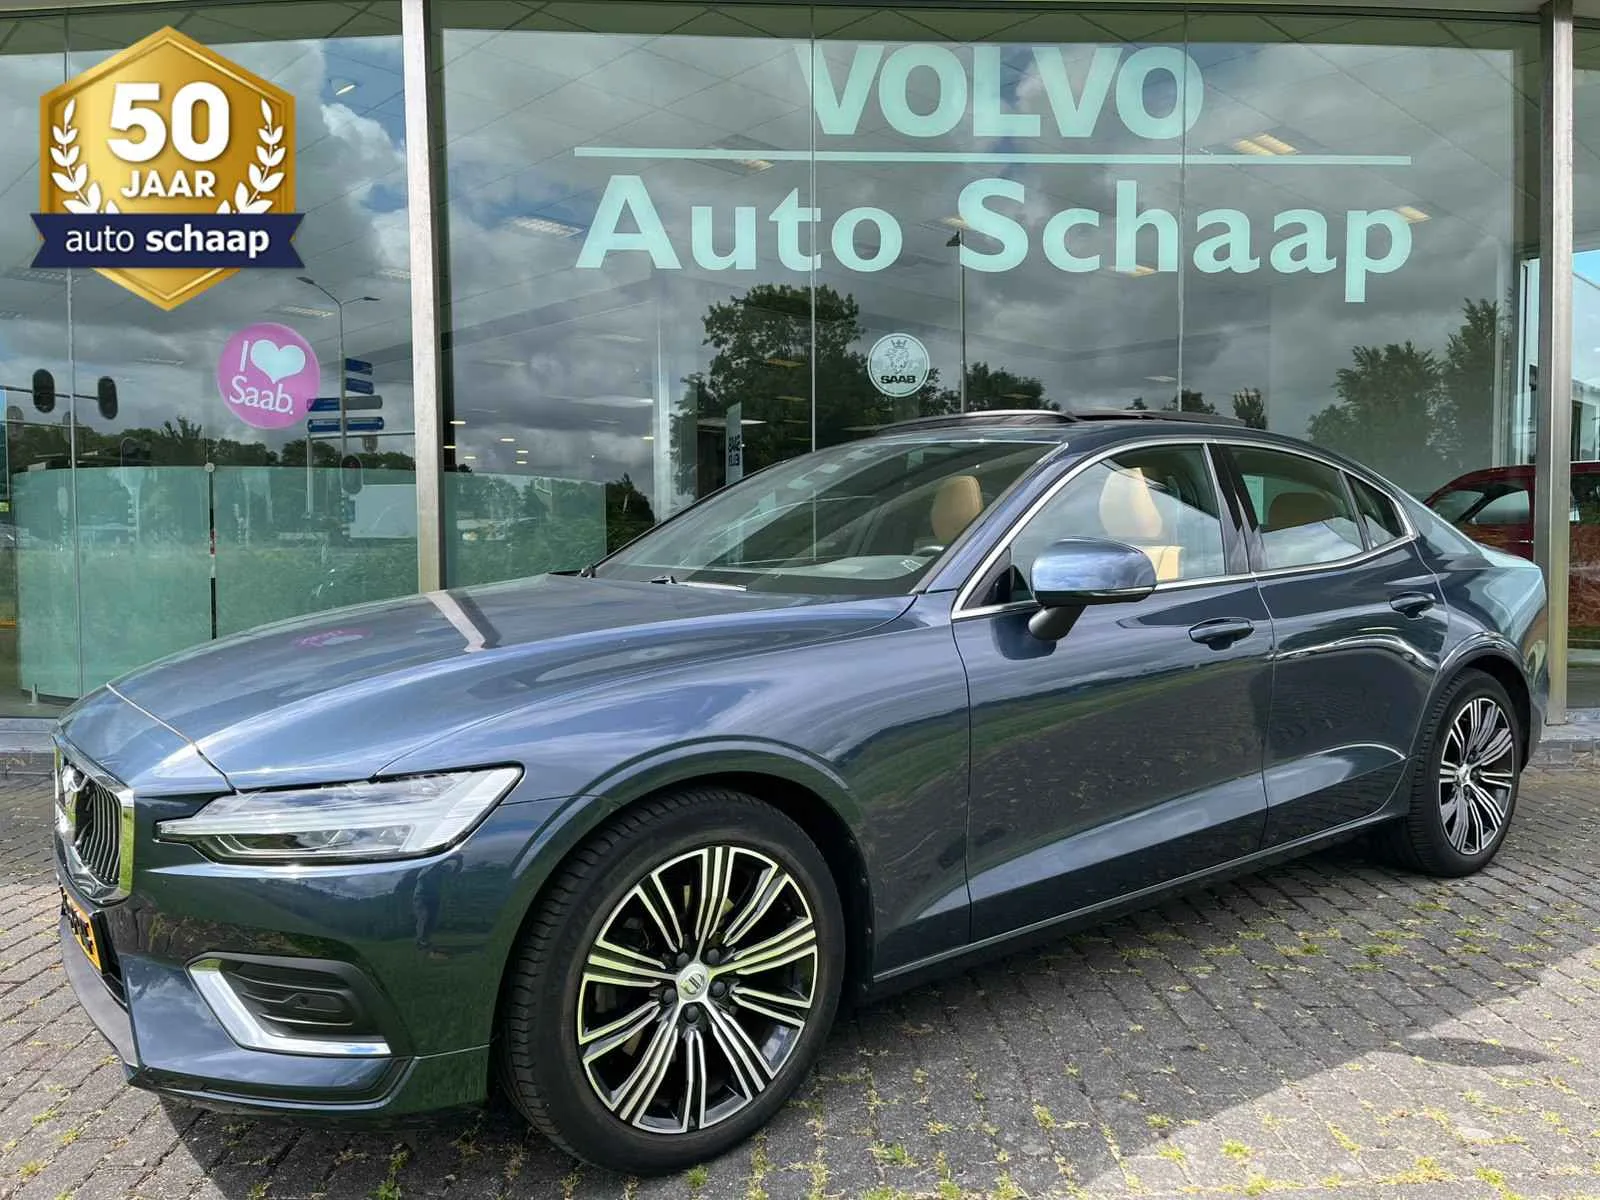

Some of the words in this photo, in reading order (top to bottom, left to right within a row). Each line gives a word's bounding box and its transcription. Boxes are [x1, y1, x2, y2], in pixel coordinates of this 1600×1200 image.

[793, 43, 1204, 140] VOLVO
[575, 174, 904, 273] Auto
[957, 177, 1413, 303] Schaap
[880, 374, 917, 385] SAAB
